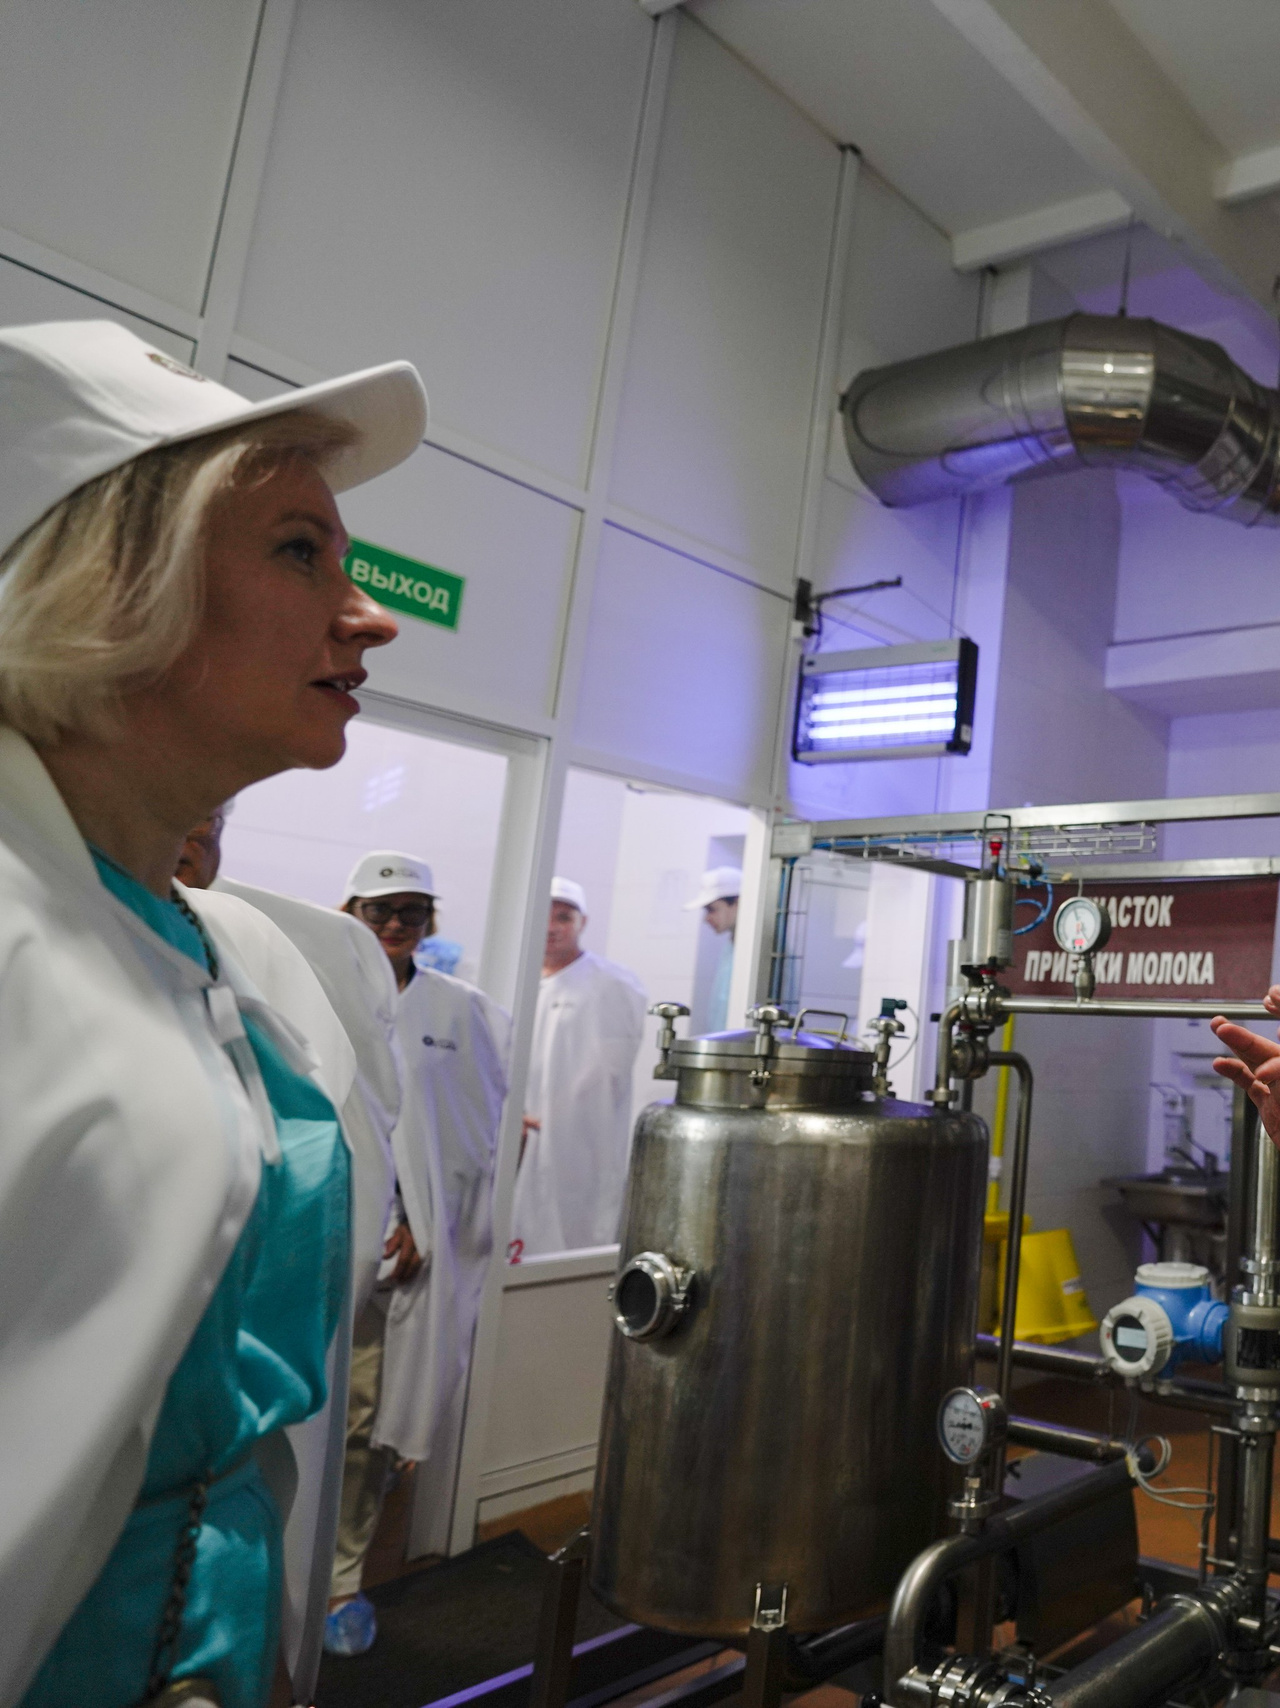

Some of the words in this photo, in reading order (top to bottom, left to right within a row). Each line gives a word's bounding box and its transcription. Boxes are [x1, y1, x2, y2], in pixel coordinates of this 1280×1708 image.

[351, 558, 450, 615] ВЫХОД
[1093, 895, 1174, 928] АСТОК
[1024, 950, 1124, 985] ПРИЕКИ
[1126, 951, 1215, 985] МОЛОКА
